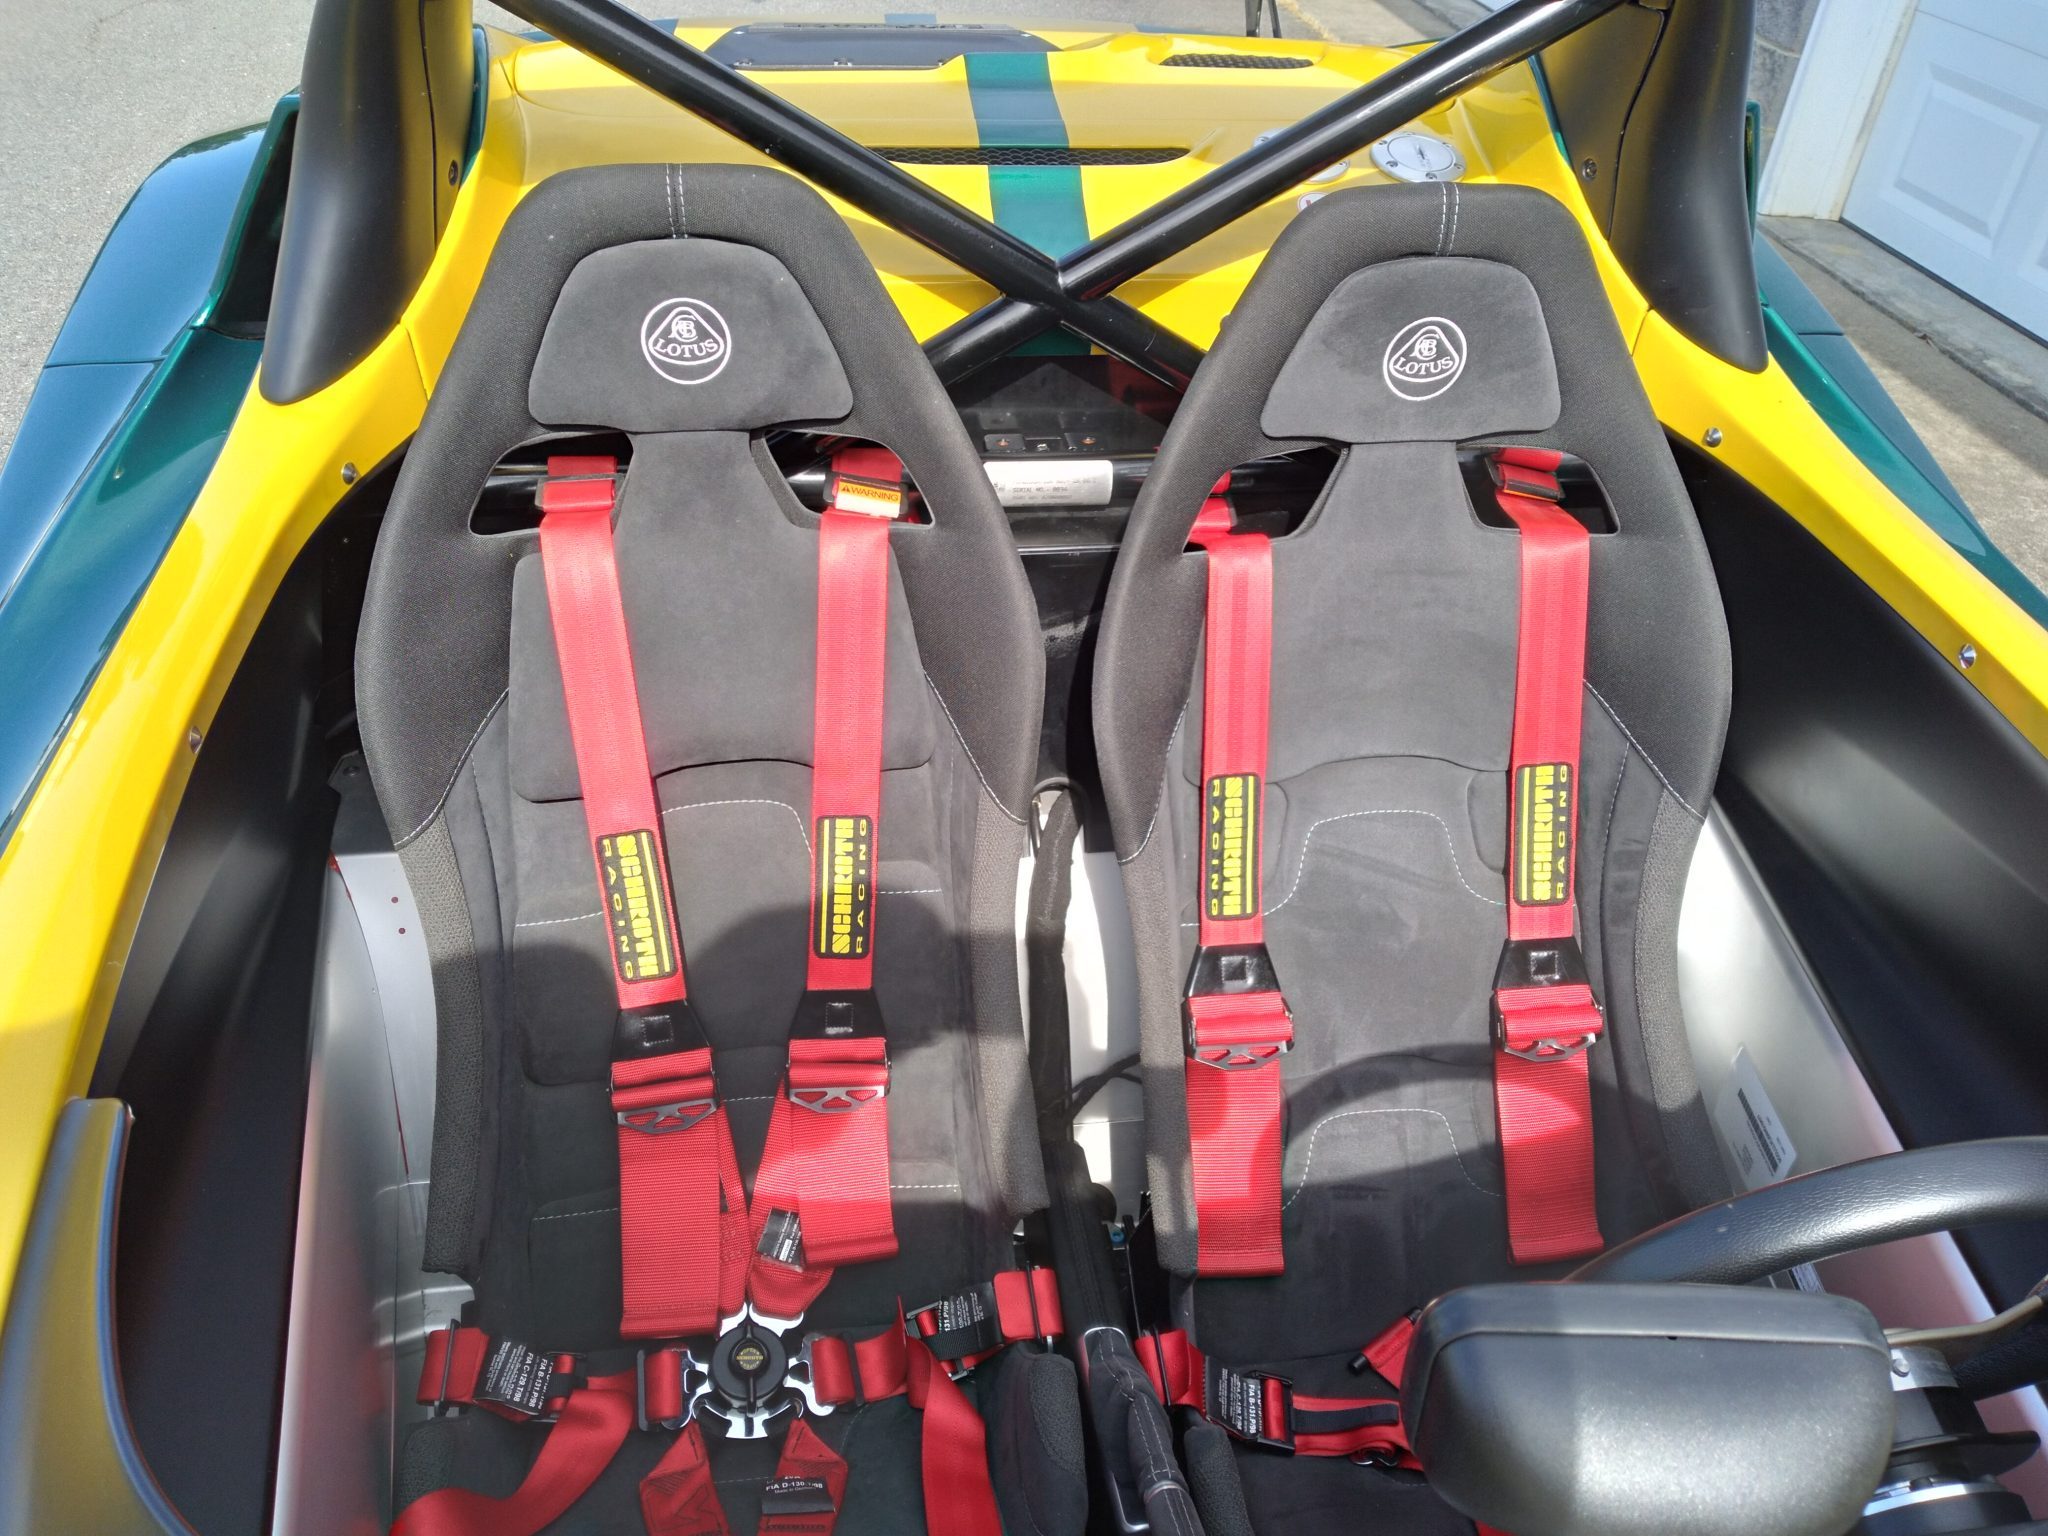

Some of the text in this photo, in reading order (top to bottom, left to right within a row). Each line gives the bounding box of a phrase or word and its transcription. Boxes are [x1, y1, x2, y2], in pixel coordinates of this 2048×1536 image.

[654, 338, 718, 358] LOTUS
[1394, 356, 1454, 375] LOTUS
[851, 487, 899, 502] WARNING
[832, 818, 854, 954] SCHROTH
[856, 818, 867, 954] RACING
[1212, 779, 1220, 916] RACING
[1223, 777, 1243, 916] SCHROTH
[1533, 765, 1554, 901] SCHROTH
[1556, 764, 1568, 899] RACING
[602, 839, 634, 979] RACING
[616, 834, 659, 976] SCHROTH
[526, 1352, 534, 1364] FIA
[539, 1358, 548, 1370] FIA
[1248, 1384, 1256, 1396] FIA
[766, 1484, 780, 1492] FIA
